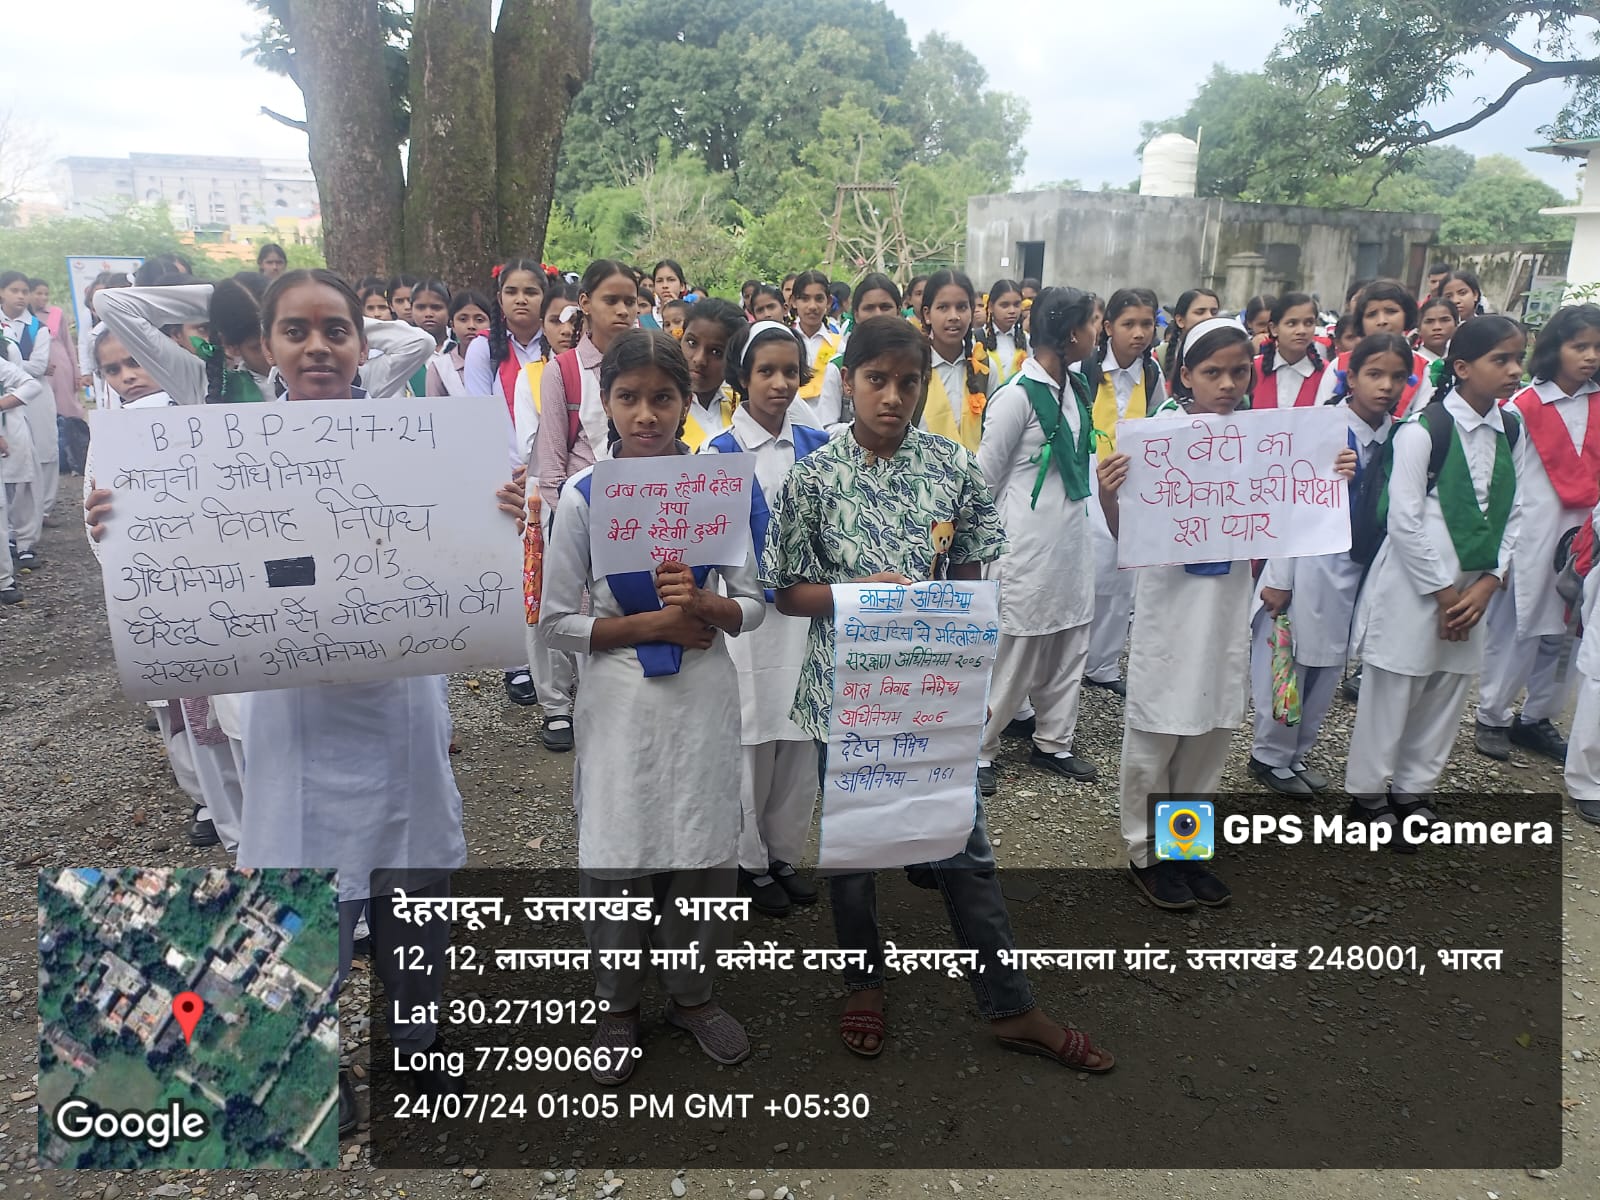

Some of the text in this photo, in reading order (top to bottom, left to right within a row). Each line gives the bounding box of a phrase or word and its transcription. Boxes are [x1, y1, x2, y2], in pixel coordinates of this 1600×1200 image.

[1142, 420, 1294, 469] हर बेटी का
[113, 453, 199, 504] कानूनी
[605, 469, 744, 499] जब तक रहेगी दहेज
[1140, 467, 1247, 509] अधिकार
[1291, 459, 1343, 509] शिक्षा
[127, 483, 439, 543] बाल विवाह निषेध
[607, 518, 642, 541] बेटी
[1221, 512, 1279, 541] प्यार
[333, 548, 401, 582] 2013
[858, 584, 907, 611] कानूनी
[259, 632, 387, 677] अधिनियम
[399, 625, 471, 656] 2006
[842, 681, 872, 700] बाल
[880, 676, 912, 696] विवाह
